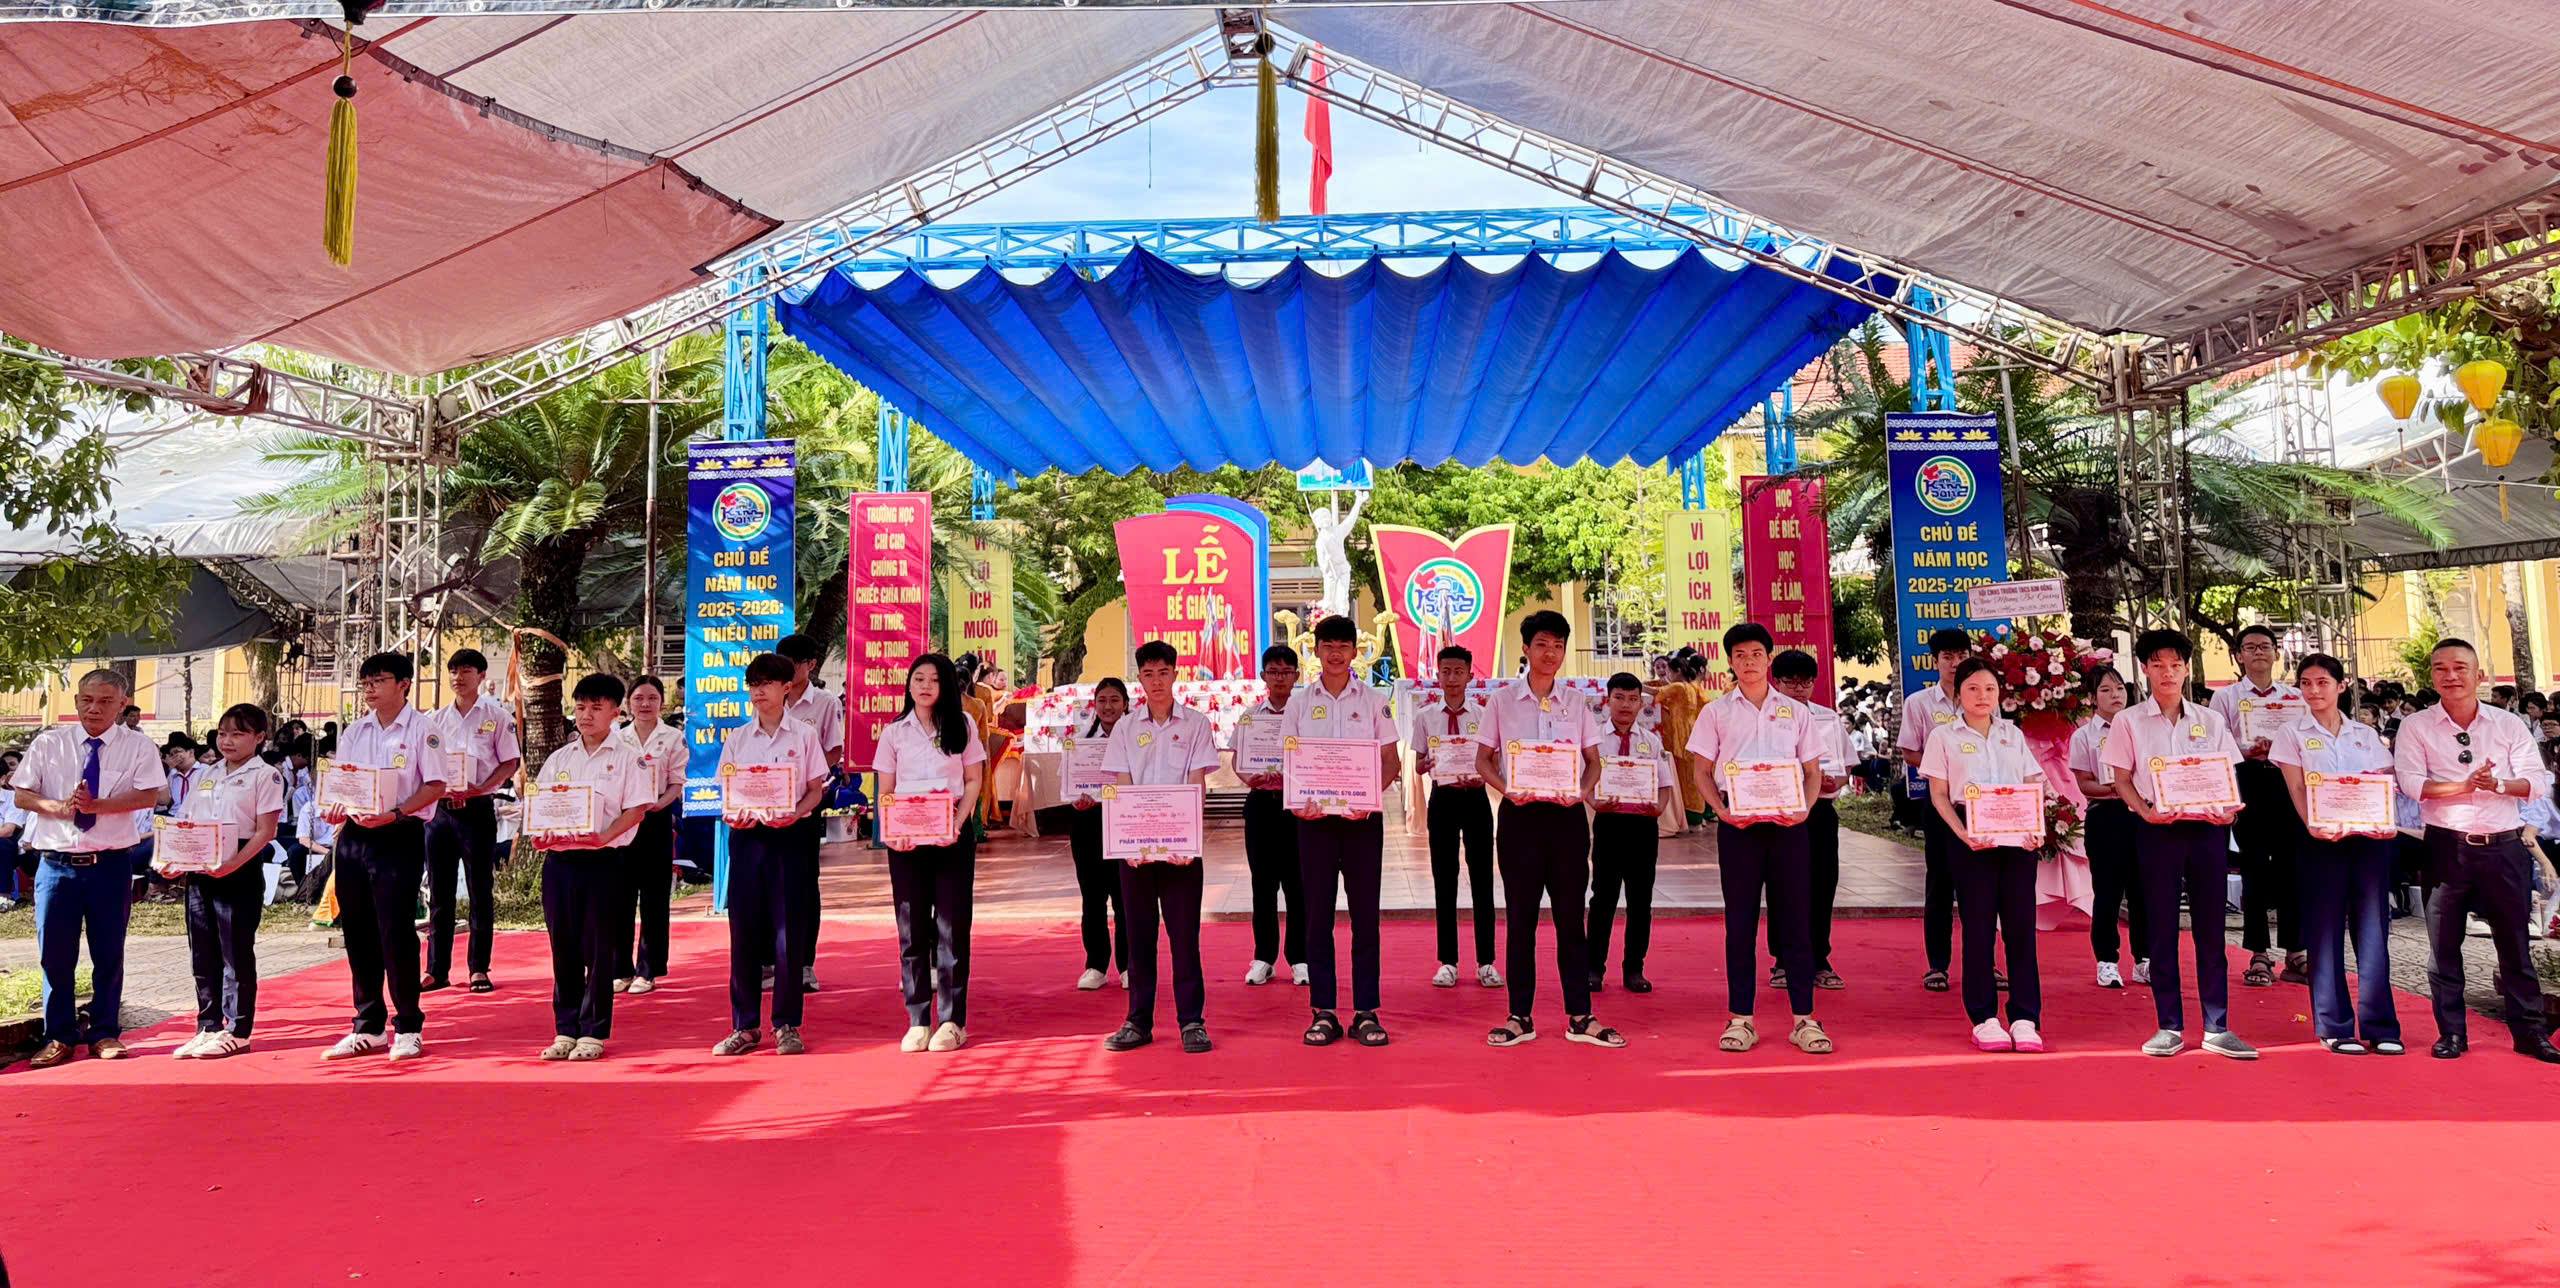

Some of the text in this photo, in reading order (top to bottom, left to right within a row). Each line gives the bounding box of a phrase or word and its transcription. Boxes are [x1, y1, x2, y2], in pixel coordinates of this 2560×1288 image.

[1775, 489, 1792, 511] HỌC
[867, 503, 915, 526] TRƯỜNG HỌC
[1691, 518, 1704, 541] VÌ
[1769, 513, 1802, 541] ĐỂ BIẾT,
[1920, 521, 1978, 541] CHỦ ĐỀ
[874, 528, 906, 550] CHỈ CHO
[714, 545, 770, 567] CHỦ ĐỀ
[1162, 524, 1229, 585] LỄ
[1688, 550, 1709, 574] LỢI
[1778, 551, 1795, 574] HỌC
[1913, 549, 1988, 570] NĂM HỌC
[871, 557, 908, 577] CHÚNG TA
[705, 574, 778, 593] NĂM HỌC
[856, 582, 921, 604] CHIẾC CHÌA KHÓA
[1688, 578, 1712, 600] ÍCH
[1771, 575, 1805, 603] ĐỂ LÀM,
[697, 600, 784, 617] 2025-2026:
[1167, 586, 1225, 621] BẾ GIẢG
[1914, 598, 1960, 618] THIẾU
[870, 611, 906, 632] TRI THỨC,
[964, 616, 998, 639] MƯỜI
[1682, 608, 1721, 631] TRĂM
[1775, 606, 1805, 636] HỌC ĐỂ
[703, 622, 779, 642] THIẾU NHI
[703, 646, 773, 668] ĐÀ NẴ
[866, 641, 909, 660] HỌC TRONG
[966, 646, 997, 664] ĂM
[1911, 652, 1938, 671] VỮ
[695, 674, 738, 693] VỮNG
[864, 663, 909, 689] CUỘC SỐNG
[705, 698, 740, 718] TIẾN
[860, 692, 906, 713] LÀ CÔNG VI
[696, 724, 716, 744] KỶ
